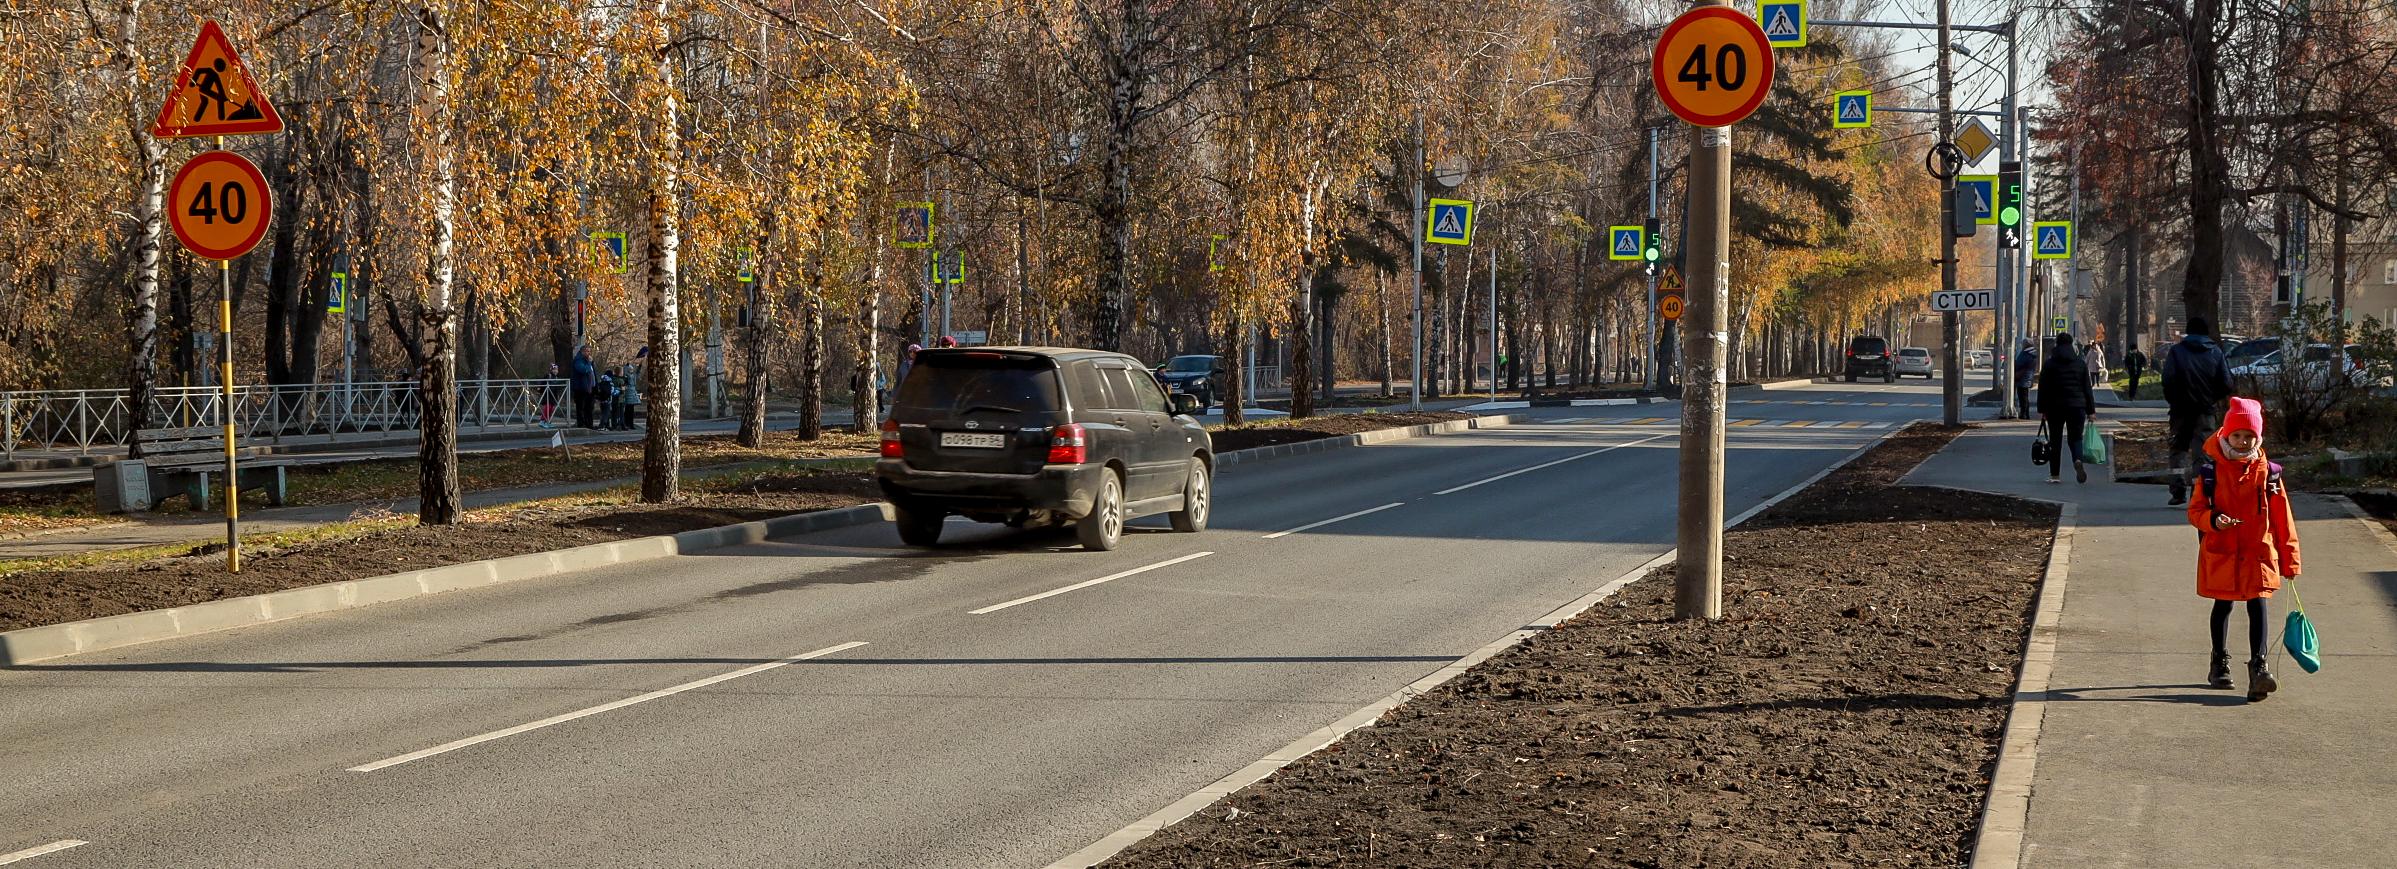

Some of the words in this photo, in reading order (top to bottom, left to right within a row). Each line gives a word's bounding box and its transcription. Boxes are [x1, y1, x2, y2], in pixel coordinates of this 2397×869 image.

[1677, 43, 1747, 91] 40
[2010, 185, 2020, 203] 5
[188, 181, 247, 225] 40
[1652, 233, 1660, 246] 5
[1665, 302, 1679, 312] 40
[1937, 292, 1990, 309] СТОП
